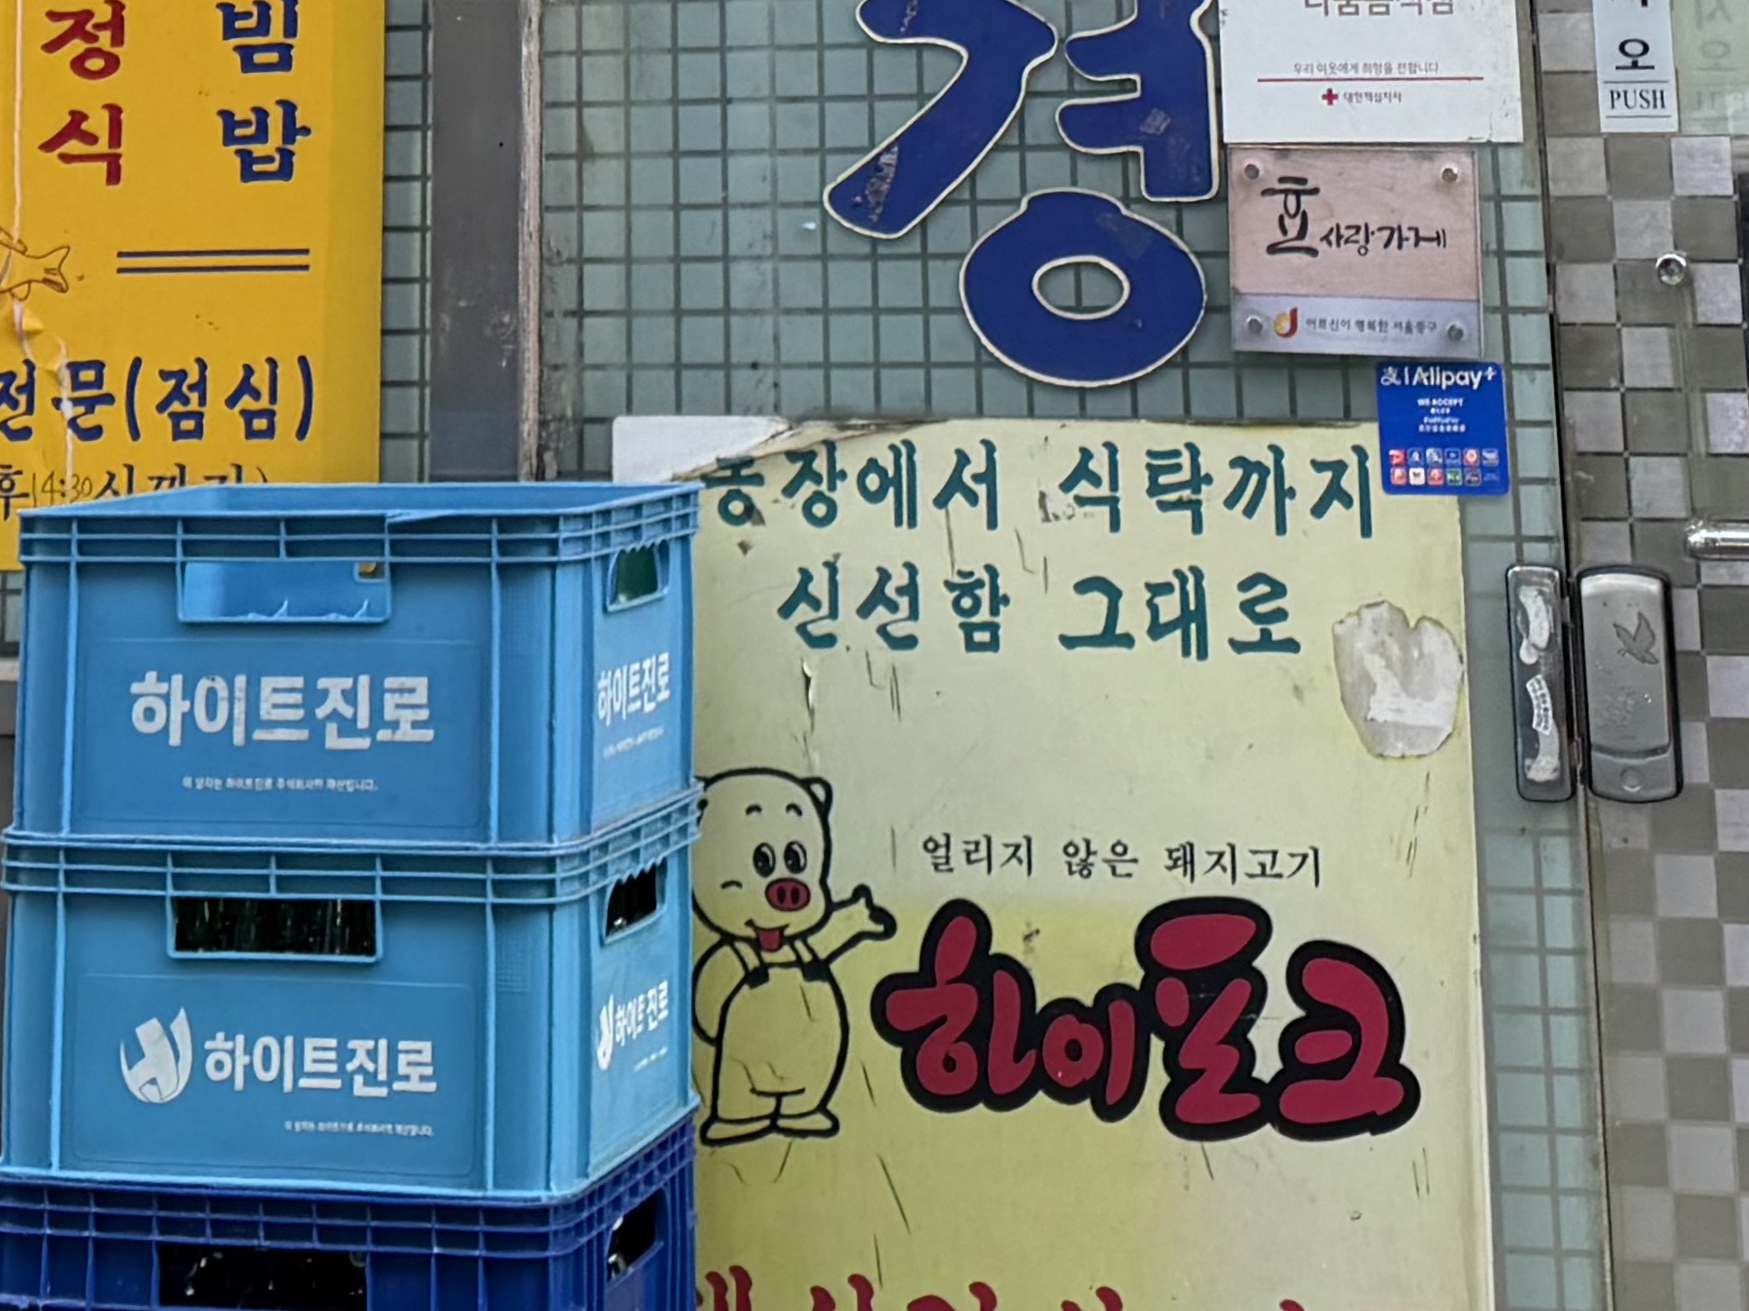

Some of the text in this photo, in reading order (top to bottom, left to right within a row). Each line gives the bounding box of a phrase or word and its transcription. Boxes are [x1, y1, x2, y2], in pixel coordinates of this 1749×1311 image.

[1609, 89, 1666, 110] PUSH
[1058, 440, 1375, 539] 식탁까지
[777, 561, 1302, 660] 신선함 그대로
[129, 670, 435, 751] 하이트진로
[598, 651, 670, 727] 하이트진로
[921, 832, 1324, 888] 얼리지 않은 돼지고기
[870, 896, 1421, 1143] 하이포크
[204, 1031, 437, 1098] 하이트진로
